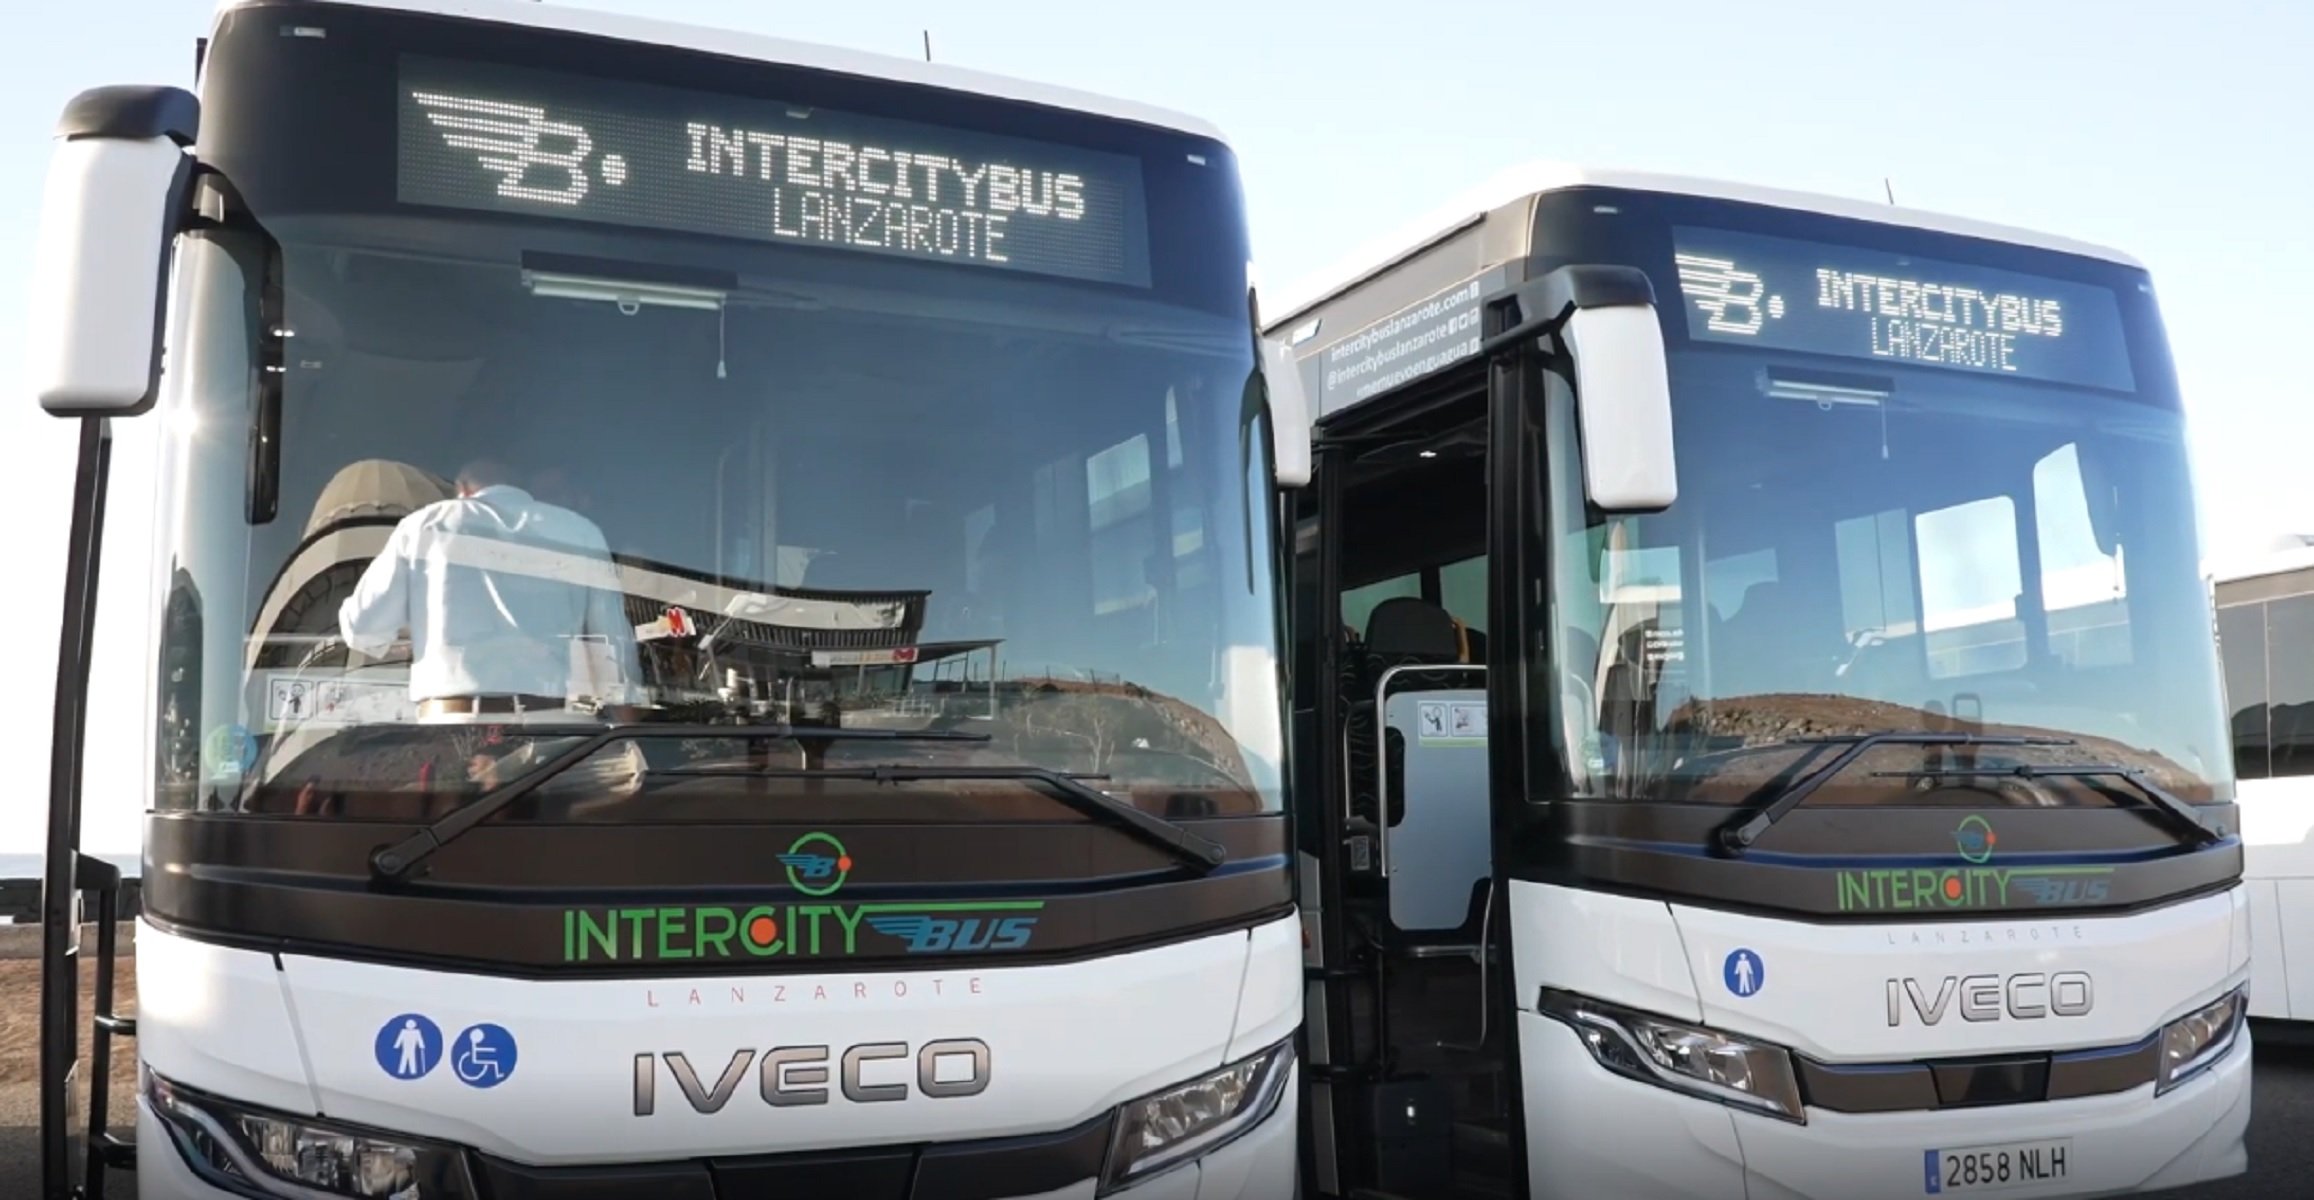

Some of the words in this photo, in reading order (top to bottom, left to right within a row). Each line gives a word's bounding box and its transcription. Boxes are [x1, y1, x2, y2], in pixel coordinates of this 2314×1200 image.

[686, 122, 1086, 221] INTERCITYBUS
[772, 192, 1009, 263] LANZAROTE
[1330, 287, 1470, 363] intercitybuslanzarote.com
[1816, 268, 2063, 337] INTERCITYBUS
[1327, 324, 1448, 391] @intercitybuslanzarote
[1872, 316, 2017, 371] LANZAROTE
[1837, 869, 2013, 911] INTERCITY
[2038, 877, 2111, 905] BUS
[565, 905, 866, 961] INTERCITY
[905, 916, 1039, 953] BUS
[1888, 925, 2084, 945] LANZAROTE
[648, 977, 982, 1008] LANZAROTE
[1886, 970, 2094, 1027] IVECO
[633, 1037, 992, 1117] IVECO
[1946, 1151, 2011, 1188] 2858
[2019, 1146, 2066, 1181] NLH
